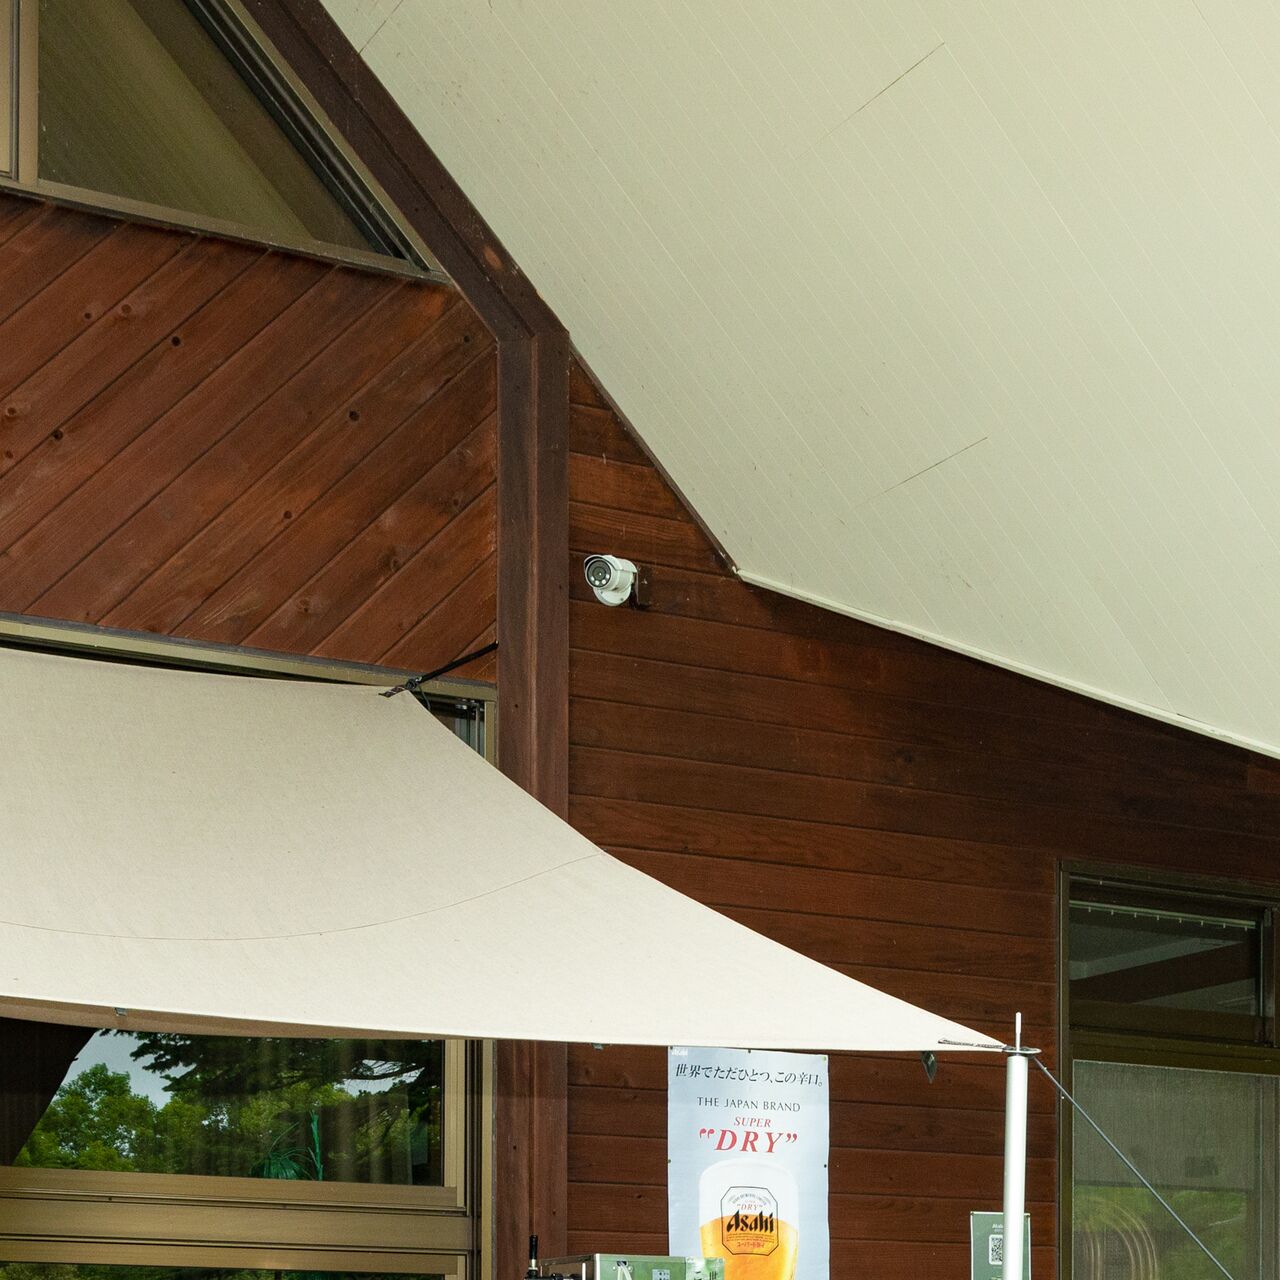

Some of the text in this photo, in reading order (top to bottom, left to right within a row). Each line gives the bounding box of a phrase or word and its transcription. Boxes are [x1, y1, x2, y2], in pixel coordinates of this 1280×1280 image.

[675, 1063, 824, 1088] 世界でただひとつ、この辛口。
[697, 1096, 801, 1112] THE JAPAN BRAND
[733, 1116, 771, 1128] SUPER
[726, 1210, 774, 1233] Asahi
